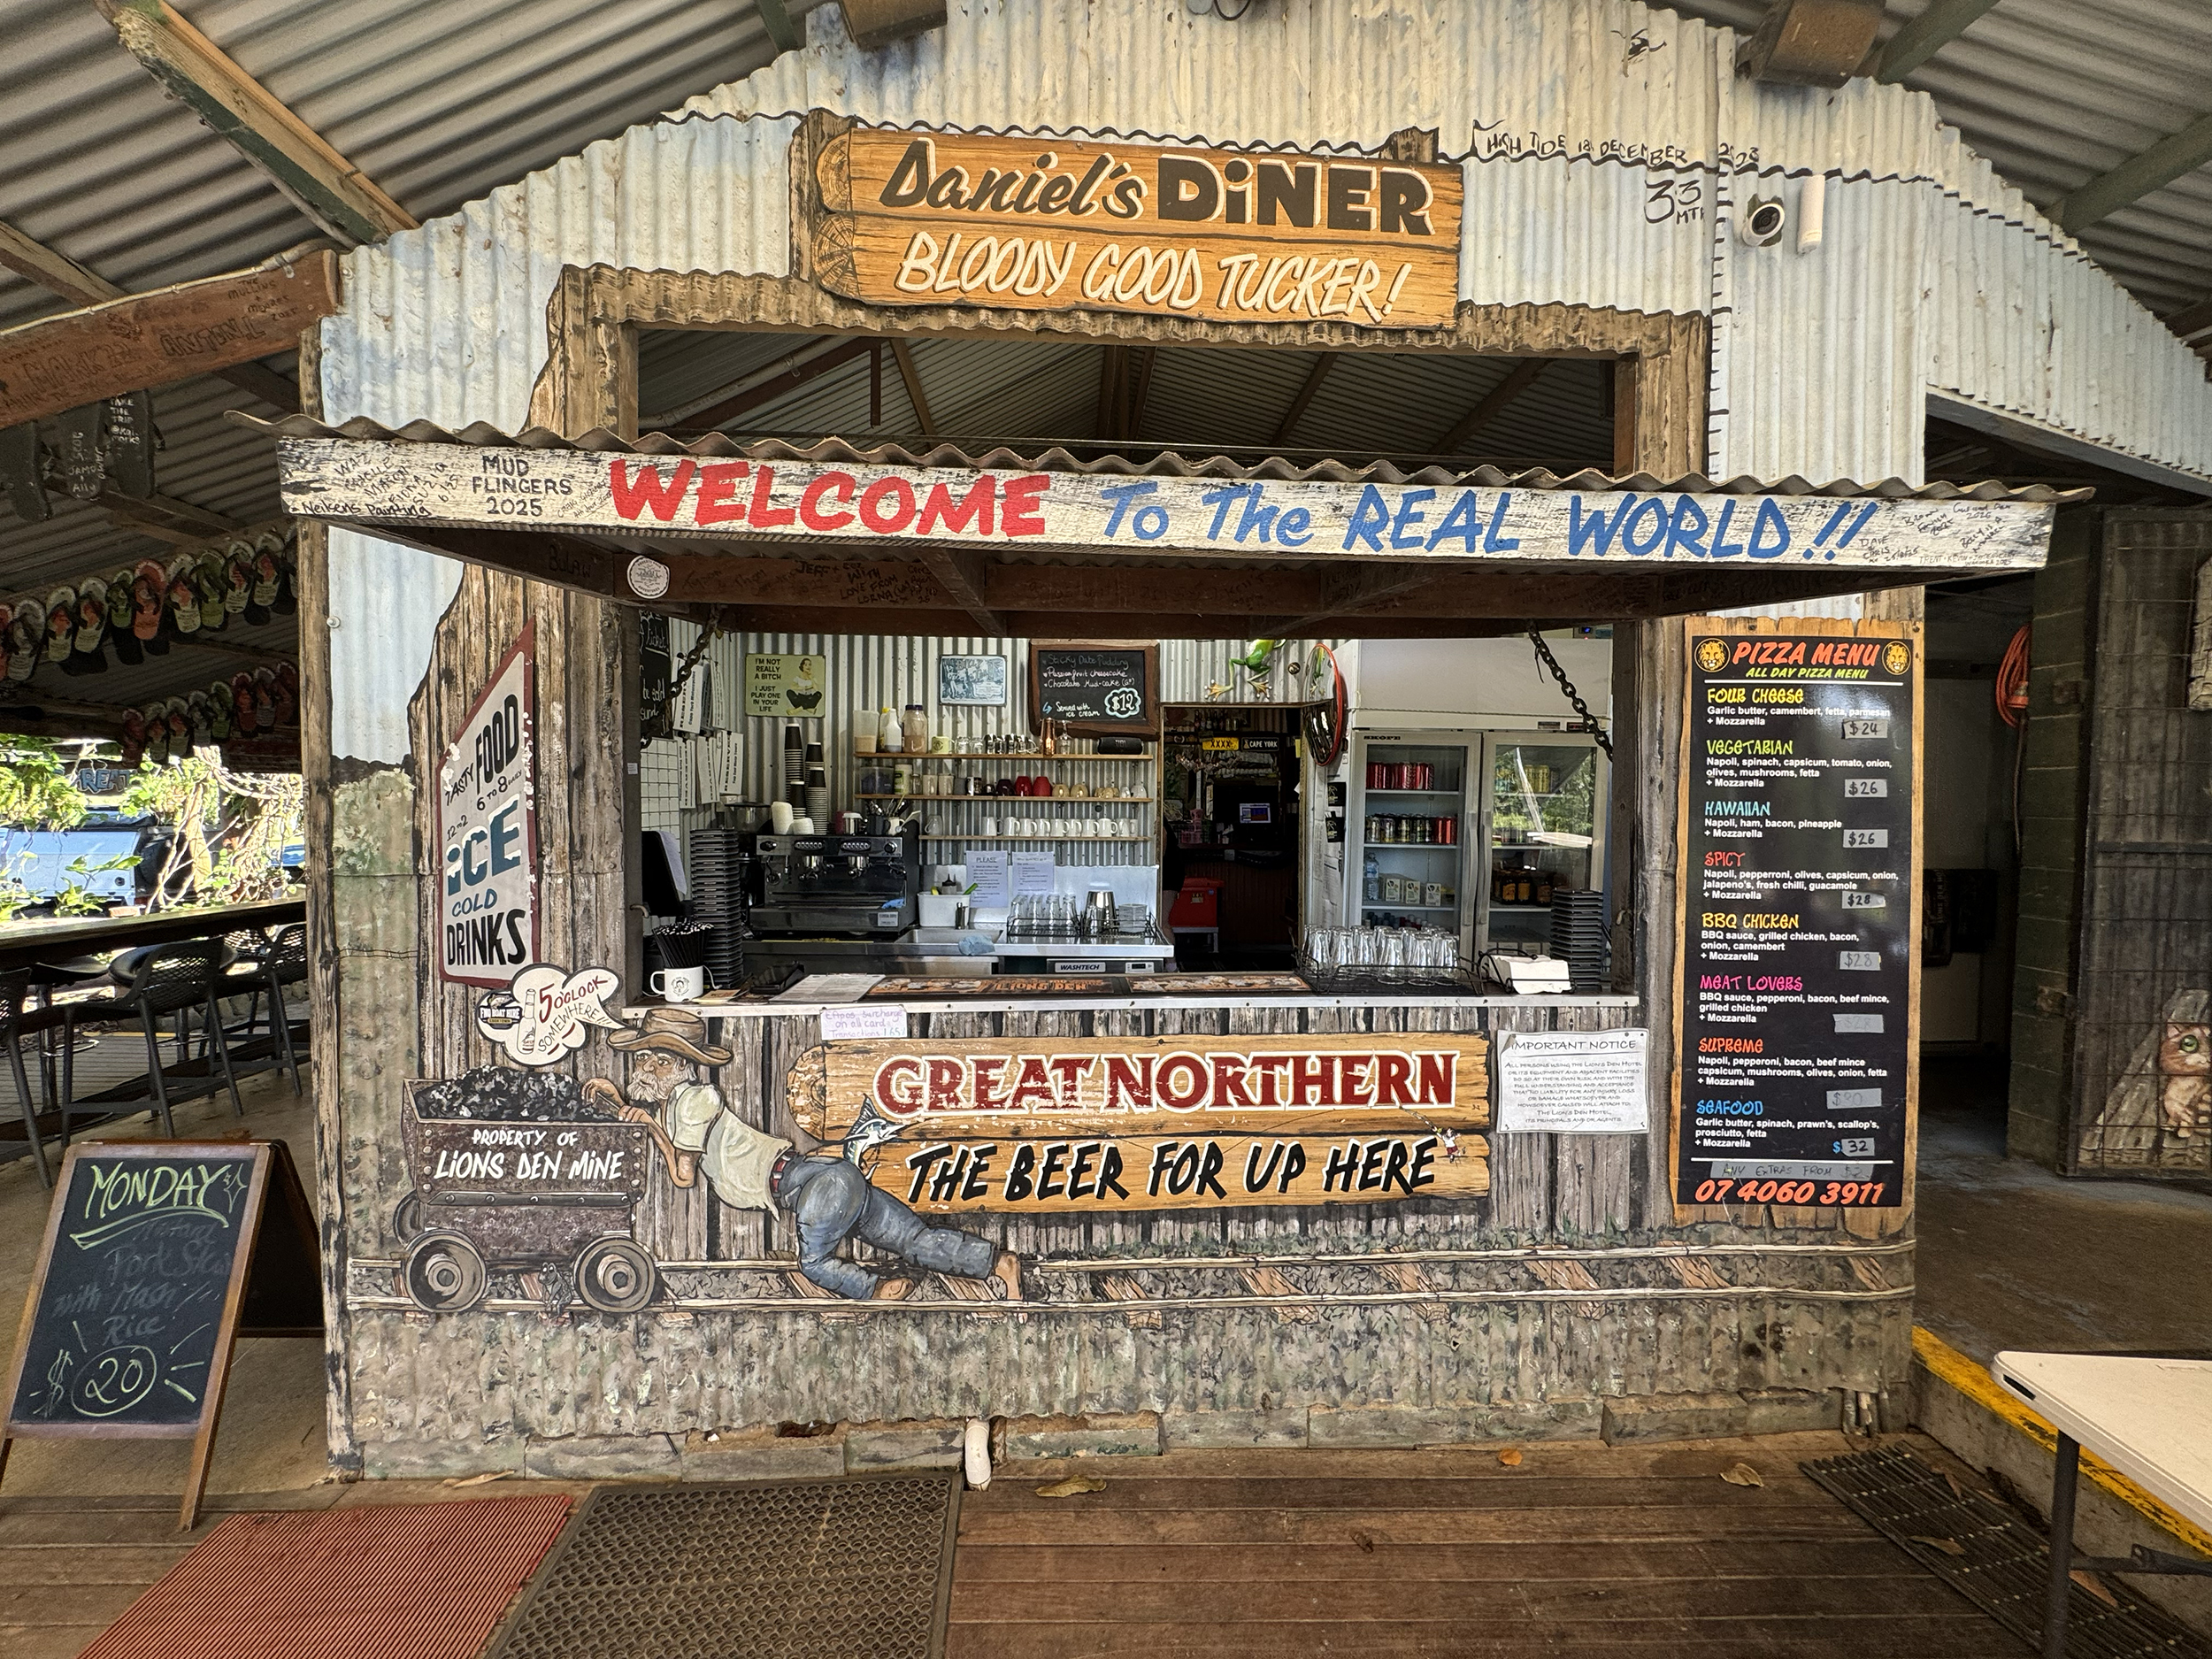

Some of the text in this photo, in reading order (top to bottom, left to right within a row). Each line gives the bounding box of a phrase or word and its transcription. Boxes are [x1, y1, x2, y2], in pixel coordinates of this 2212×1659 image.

[1529, 132, 1566, 155] TIDE
[1600, 140, 1687, 165] DECEMBER
[879, 140, 1146, 220] Daniel's
[894, 231, 1411, 324] BLOODY GOOD TUCKER!
[482, 456, 530, 476] MUD
[472, 477, 573, 495] FLINGERS
[365, 503, 431, 517] Painting
[487, 496, 542, 517] 2025
[610, 457, 1051, 538] WELCOME
[1102, 482, 1171, 541] To
[1201, 484, 1310, 547] The
[1340, 484, 1521, 553] REAL
[1732, 642, 1880, 666] PIZZA MENU
[1746, 668, 1869, 679] ALL DAY PIZZA MENU
[1111, 694, 1135, 711] $12
[1708, 688, 1803, 703] FOUR CHEESE
[1707, 706, 1890, 718] Garlic butter, camembert, fetta, parmesan
[476, 694, 520, 795] FOOD
[1707, 740, 1793, 755] VEGETARIAN
[1707, 757, 1892, 769] Napoli, spinach, capsicum, tomato, onion,
[477, 797, 485, 810] 6
[498, 776, 507, 793] 8
[1848, 780, 1878, 795] $26
[1705, 802, 1770, 816] HAWAIIAN
[1705, 818, 1842, 829] Napoli, ham, bacon, pineapple
[1847, 832, 1875, 846] $26
[1705, 852, 1745, 866] SPICY
[1704, 870, 1898, 882] Napoli, pepperroni, olives, capsicum, onion,
[451, 887, 498, 918] COLD
[1702, 913, 1799, 928] BBQ CHICKEN
[446, 908, 526, 966] DRINKS
[1701, 931, 1724, 941] BBQ
[1759, 932, 1787, 942] grilled
[1790, 933, 1827, 941] chicken,
[1830, 933, 1859, 941] bacon,
[1844, 952, 1872, 968] $28
[1701, 975, 1802, 991] MEAT LOVERS
[539, 983, 555, 1023] 5
[492, 1008, 505, 1018] BOAT
[506, 1008, 520, 1019] HIRE
[851, 1018, 861, 1027] all
[829, 1028, 879, 1038] Transactions
[1511, 1041, 1637, 1051] IMPORTANT NOTICE
[1699, 1038, 1763, 1053] SUPREME
[872, 1049, 1461, 1117] GREAT NORTHERN
[1697, 1100, 1763, 1115] SEAFOOD
[472, 1128, 579, 1148] PROPERTY OF
[516, 1152, 562, 1180] DEN
[905, 1135, 1439, 1203] THE BEER FOR UP HERE
[1803, 1165, 1832, 1177] FROM
[85, 1162, 232, 1219] MONDAY
[1695, 1180, 1884, 1204] 07 4060 3911
[86, 1357, 143, 1403] 20
